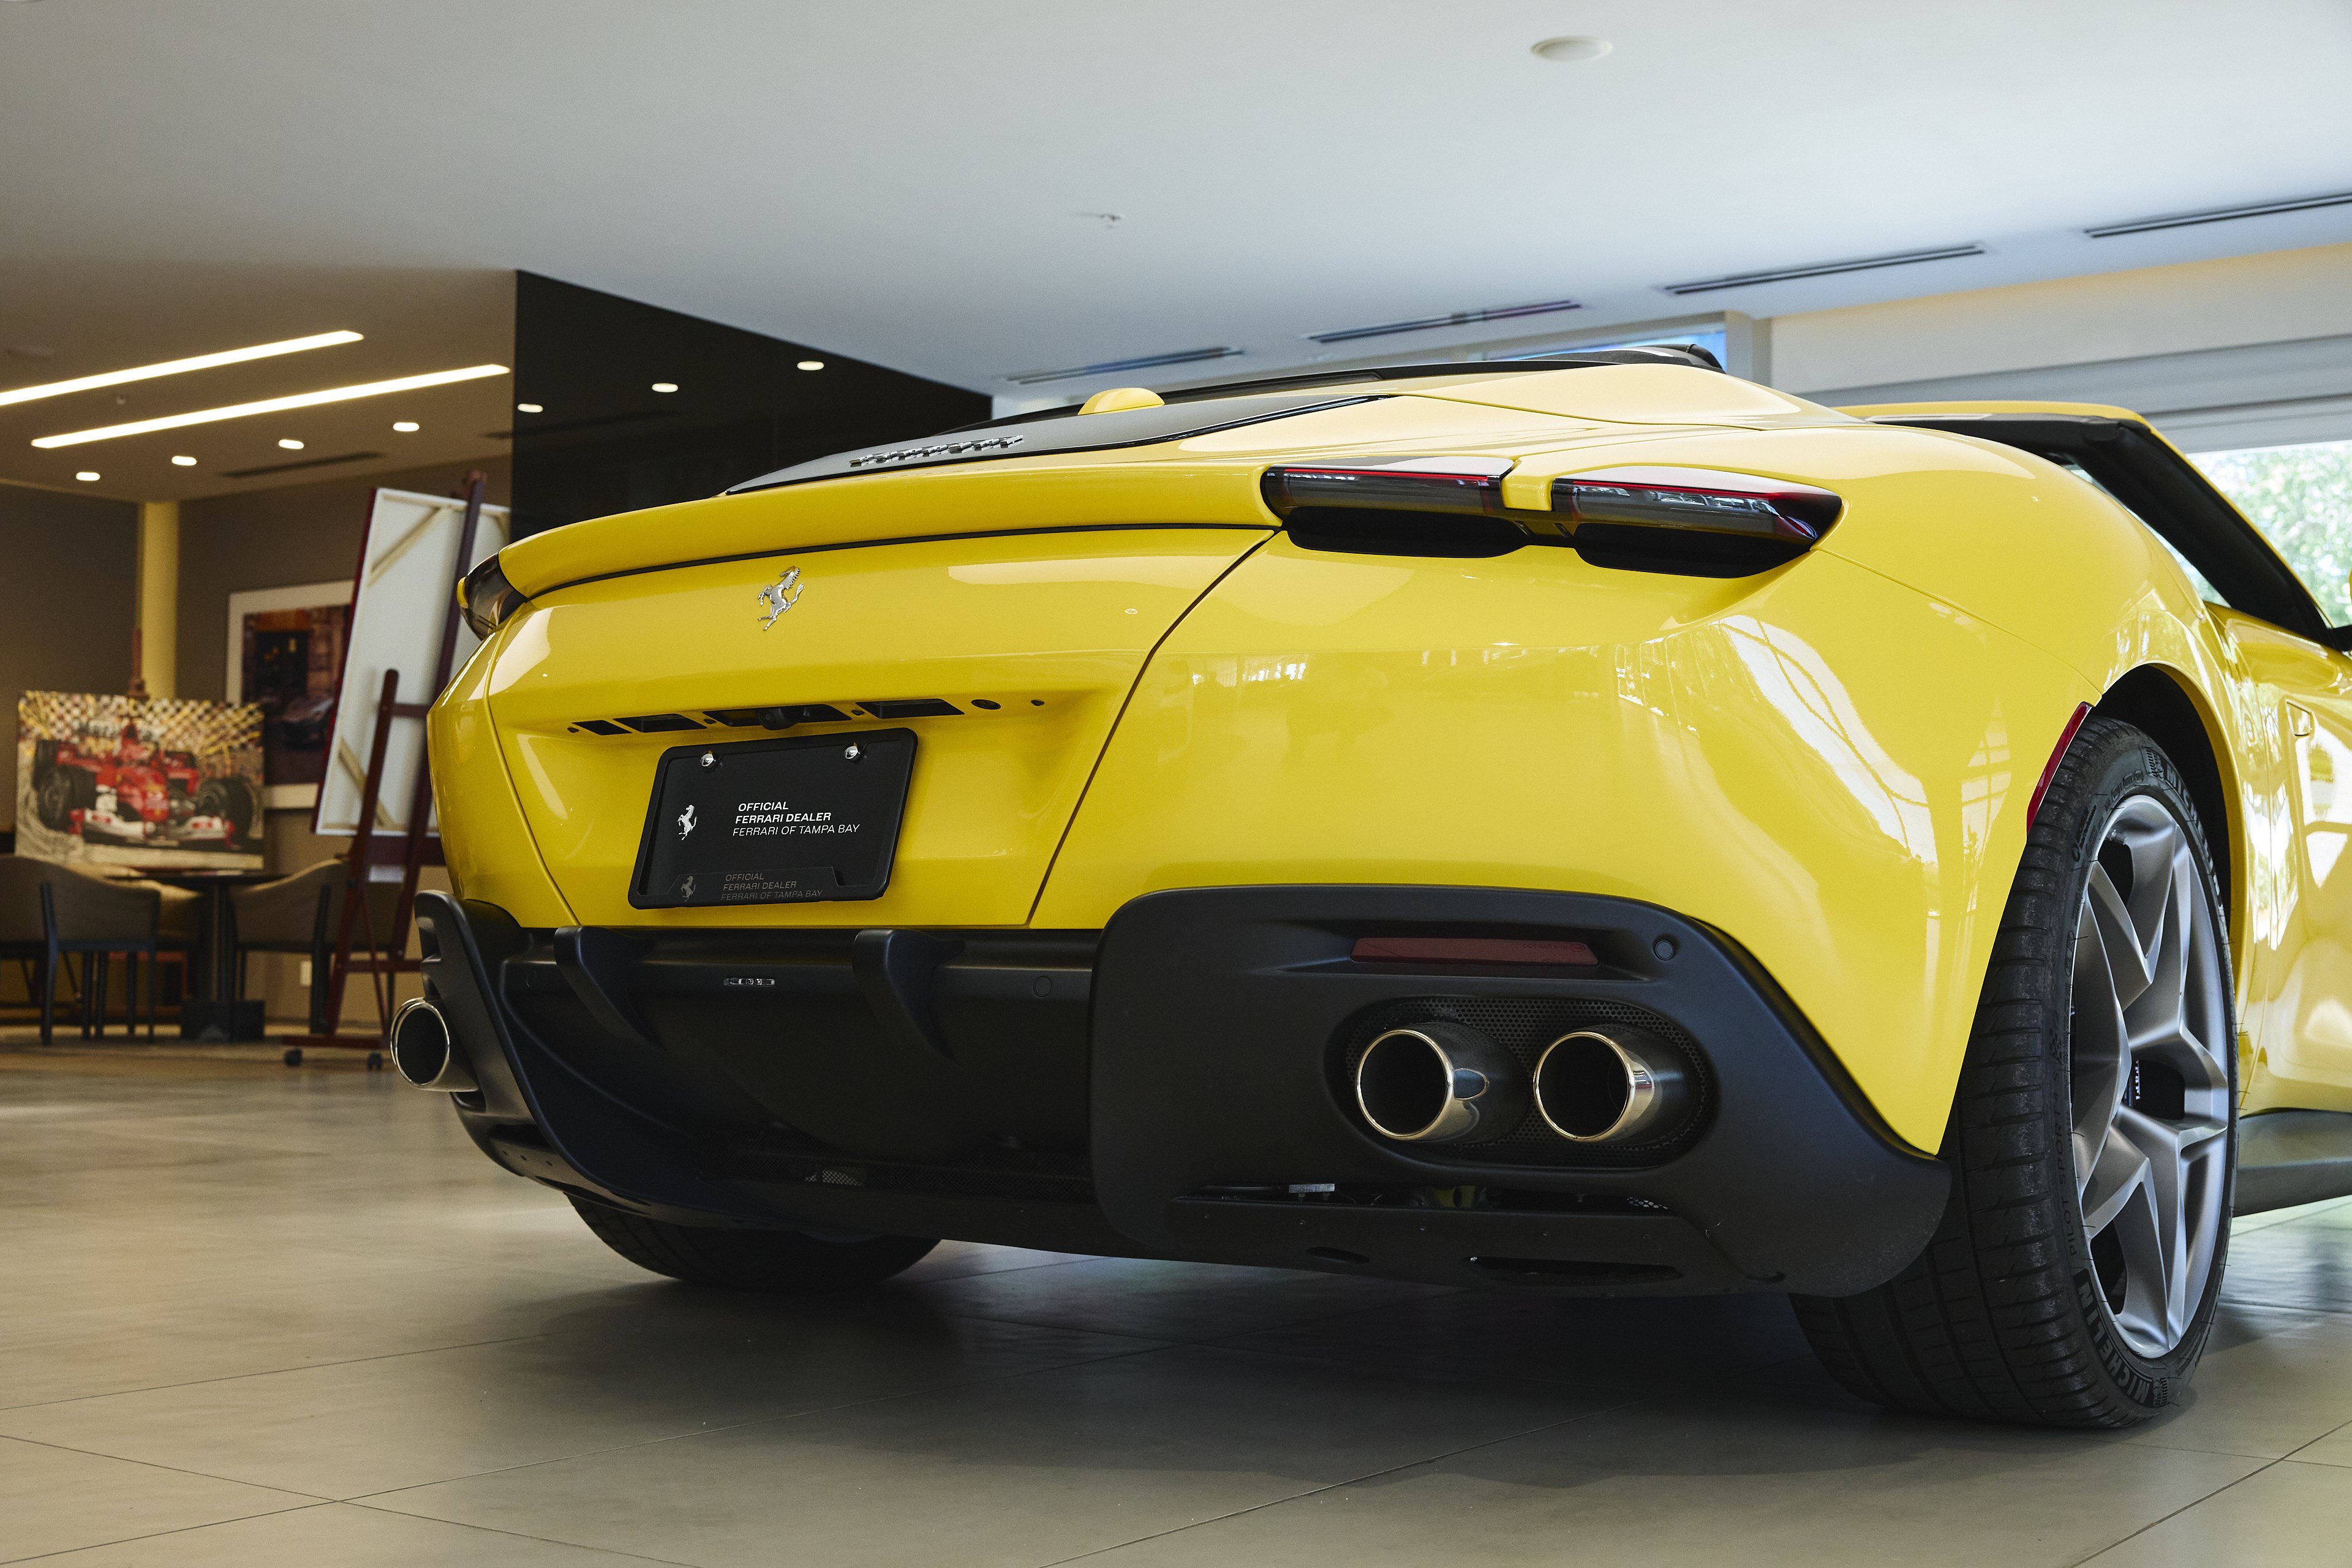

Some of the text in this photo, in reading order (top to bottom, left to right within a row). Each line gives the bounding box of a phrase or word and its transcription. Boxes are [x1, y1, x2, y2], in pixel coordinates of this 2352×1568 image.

[738, 801, 789, 812] OFFICIAL
[735, 812, 832, 824] FERRARI DEALER
[733, 824, 861, 837] FERRARI OF TAMPA BAY
[725, 873, 764, 881] OFFICIAL
[723, 881, 797, 891] FERRARI DEALER
[2054, 1108, 2067, 1185] SPORT
[2062, 1198, 2078, 1256] PILOT
[2078, 1281, 2150, 1404] MICHELIN
